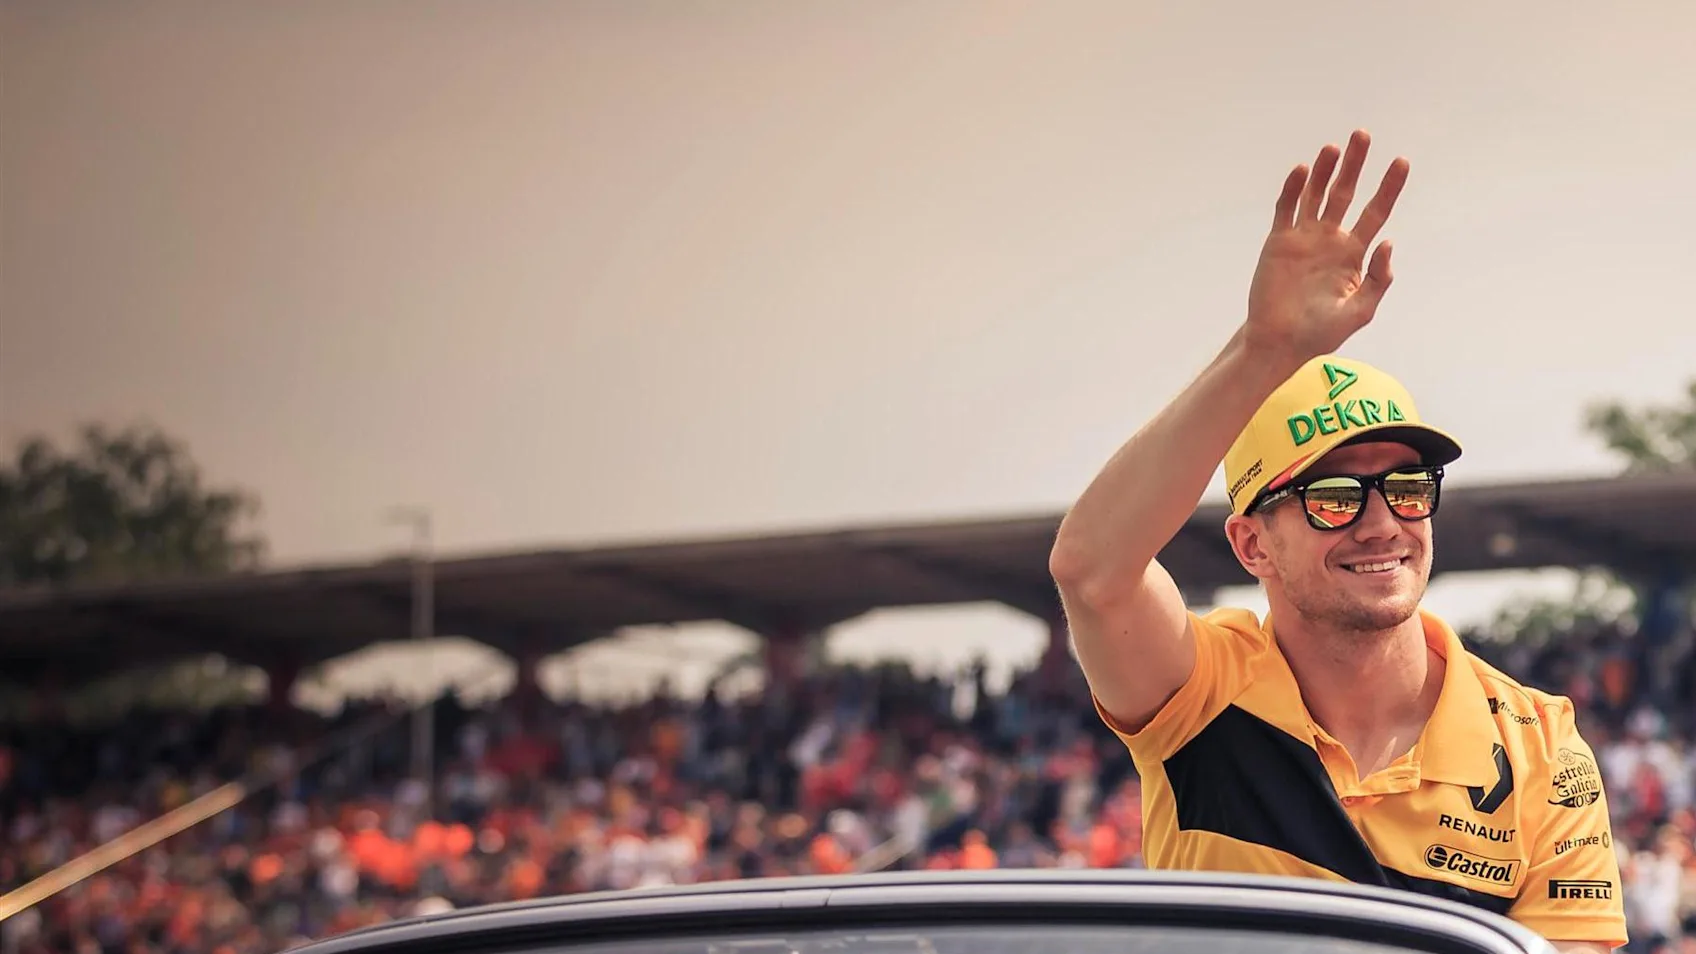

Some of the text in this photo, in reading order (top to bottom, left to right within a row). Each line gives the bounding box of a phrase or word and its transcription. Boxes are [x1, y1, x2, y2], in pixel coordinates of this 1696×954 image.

[1287, 399, 1406, 446] DEKRA
[1498, 700, 1539, 726] Microsoft
[1552, 762, 1594, 786] Estrella
[1557, 776, 1597, 797] Galicia
[1439, 814, 1516, 842] RENAULT
[1447, 852, 1512, 882] Castrol
[1549, 879, 1612, 900] PIRELLI
